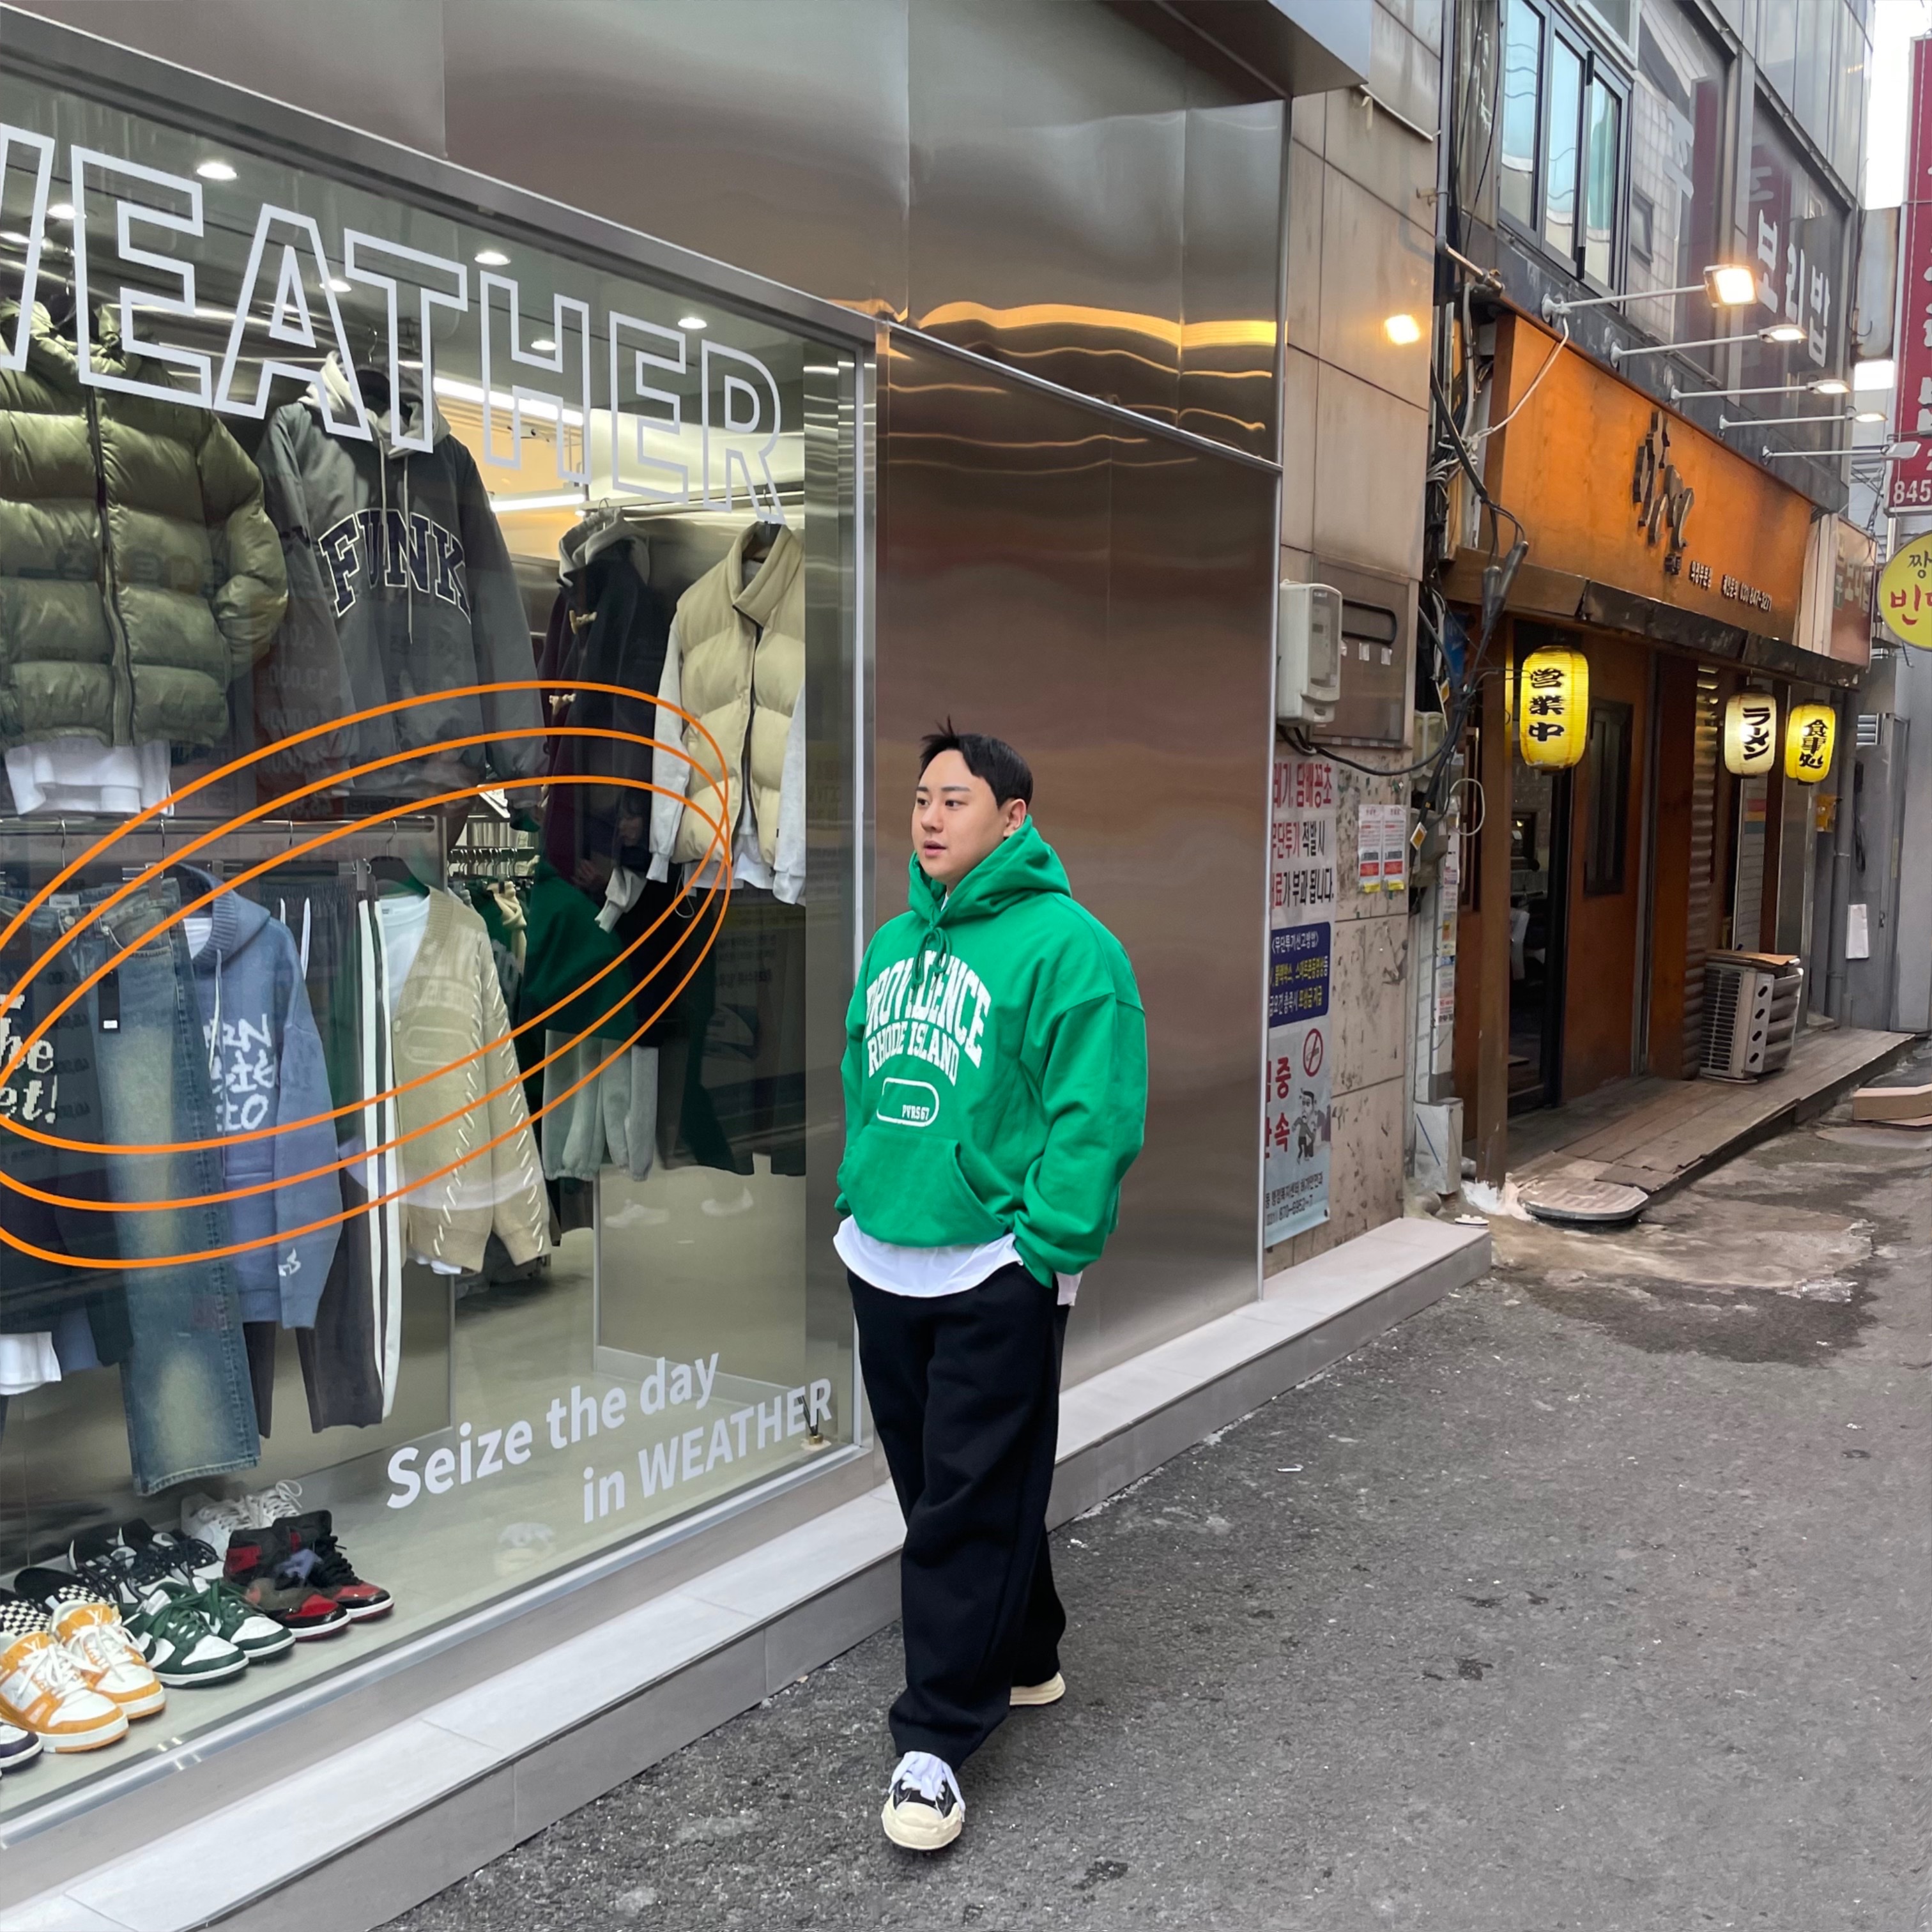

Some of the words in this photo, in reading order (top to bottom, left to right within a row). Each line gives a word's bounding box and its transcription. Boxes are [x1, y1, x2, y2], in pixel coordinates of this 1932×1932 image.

[318, 508, 471, 625] FUNK
[1529, 668, 1565, 742] 営業中
[1799, 719, 1828, 769] 食事処
[1296, 762, 1332, 808] 담배꽁초
[867, 1021, 908, 1078] RHODE
[907, 1021, 959, 1087] ISLAND
[386, 1422, 533, 1509] Seize
[546, 1385, 627, 1450] the
[640, 1353, 719, 1415] day
[583, 1466, 625, 1524] in
[638, 1378, 832, 1498] WEATHER
